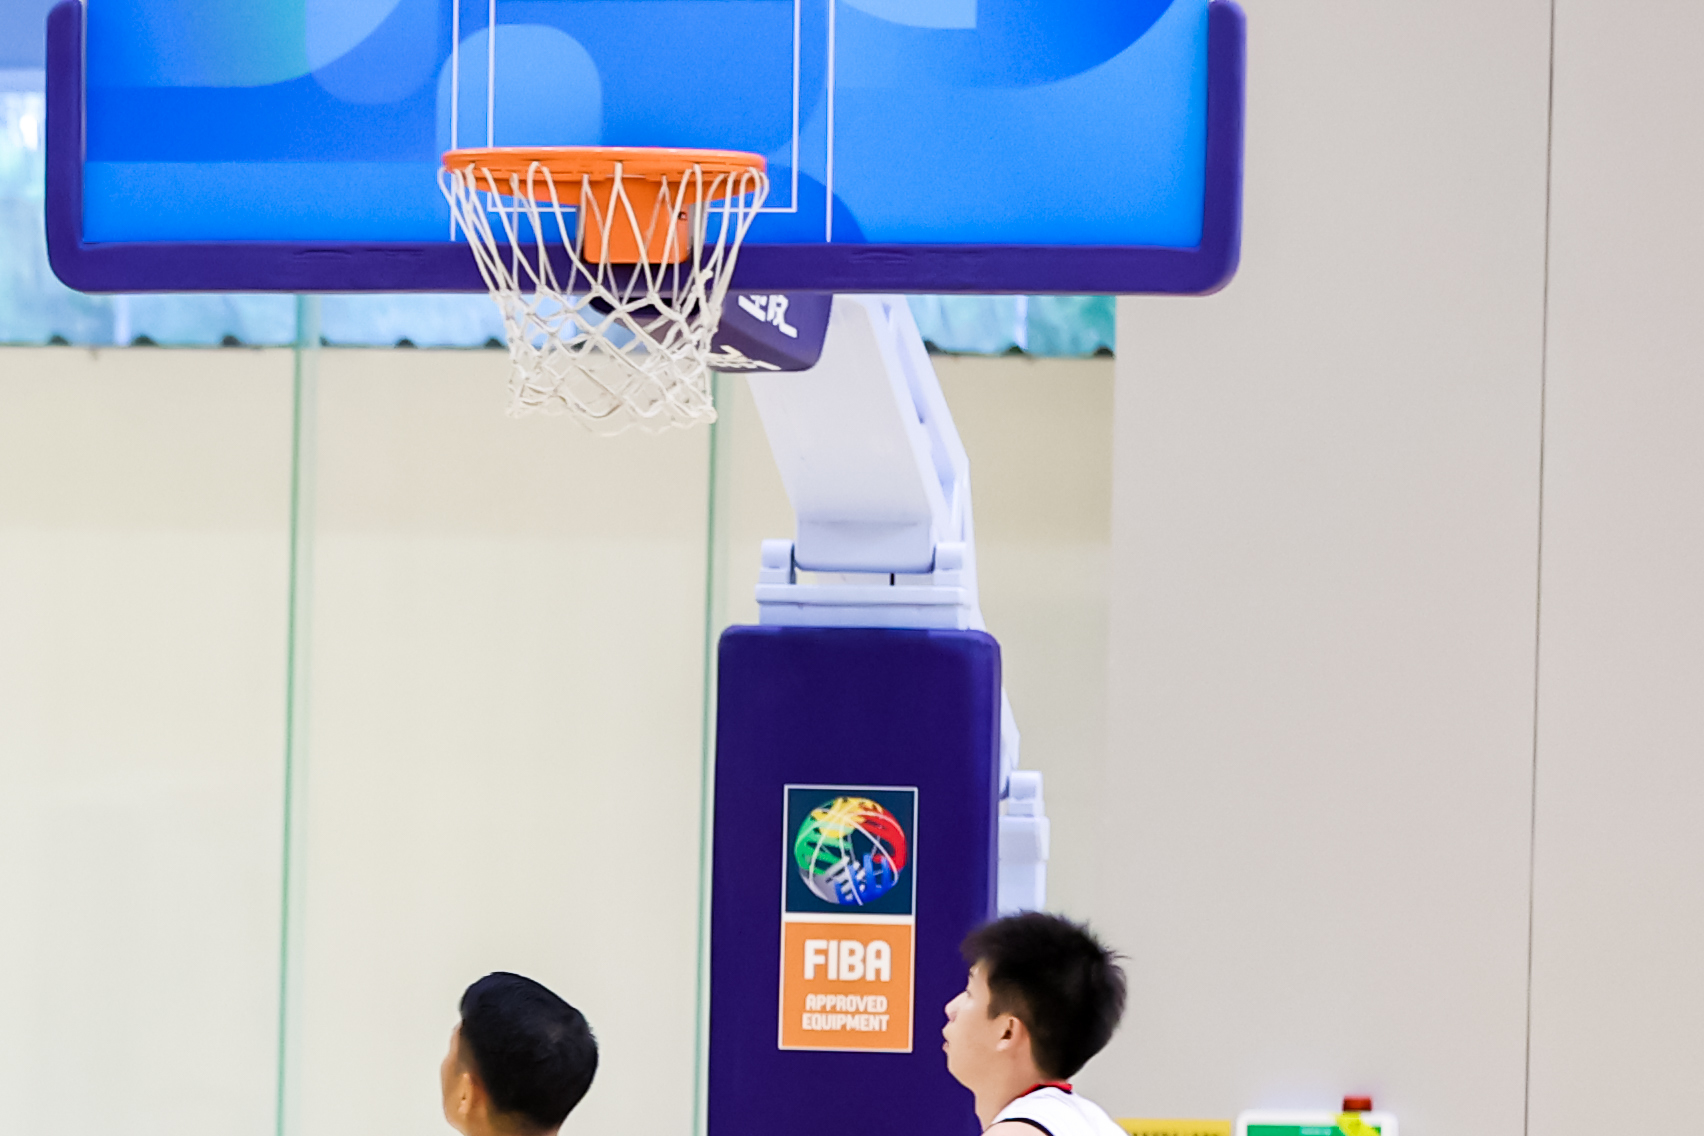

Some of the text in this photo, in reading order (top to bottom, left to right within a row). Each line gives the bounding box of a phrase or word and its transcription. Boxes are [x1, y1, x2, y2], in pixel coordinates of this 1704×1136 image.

[803, 938, 892, 982] FIBA
[805, 993, 888, 1013] APPROVED
[801, 1012, 890, 1032] EQUIPMENT
